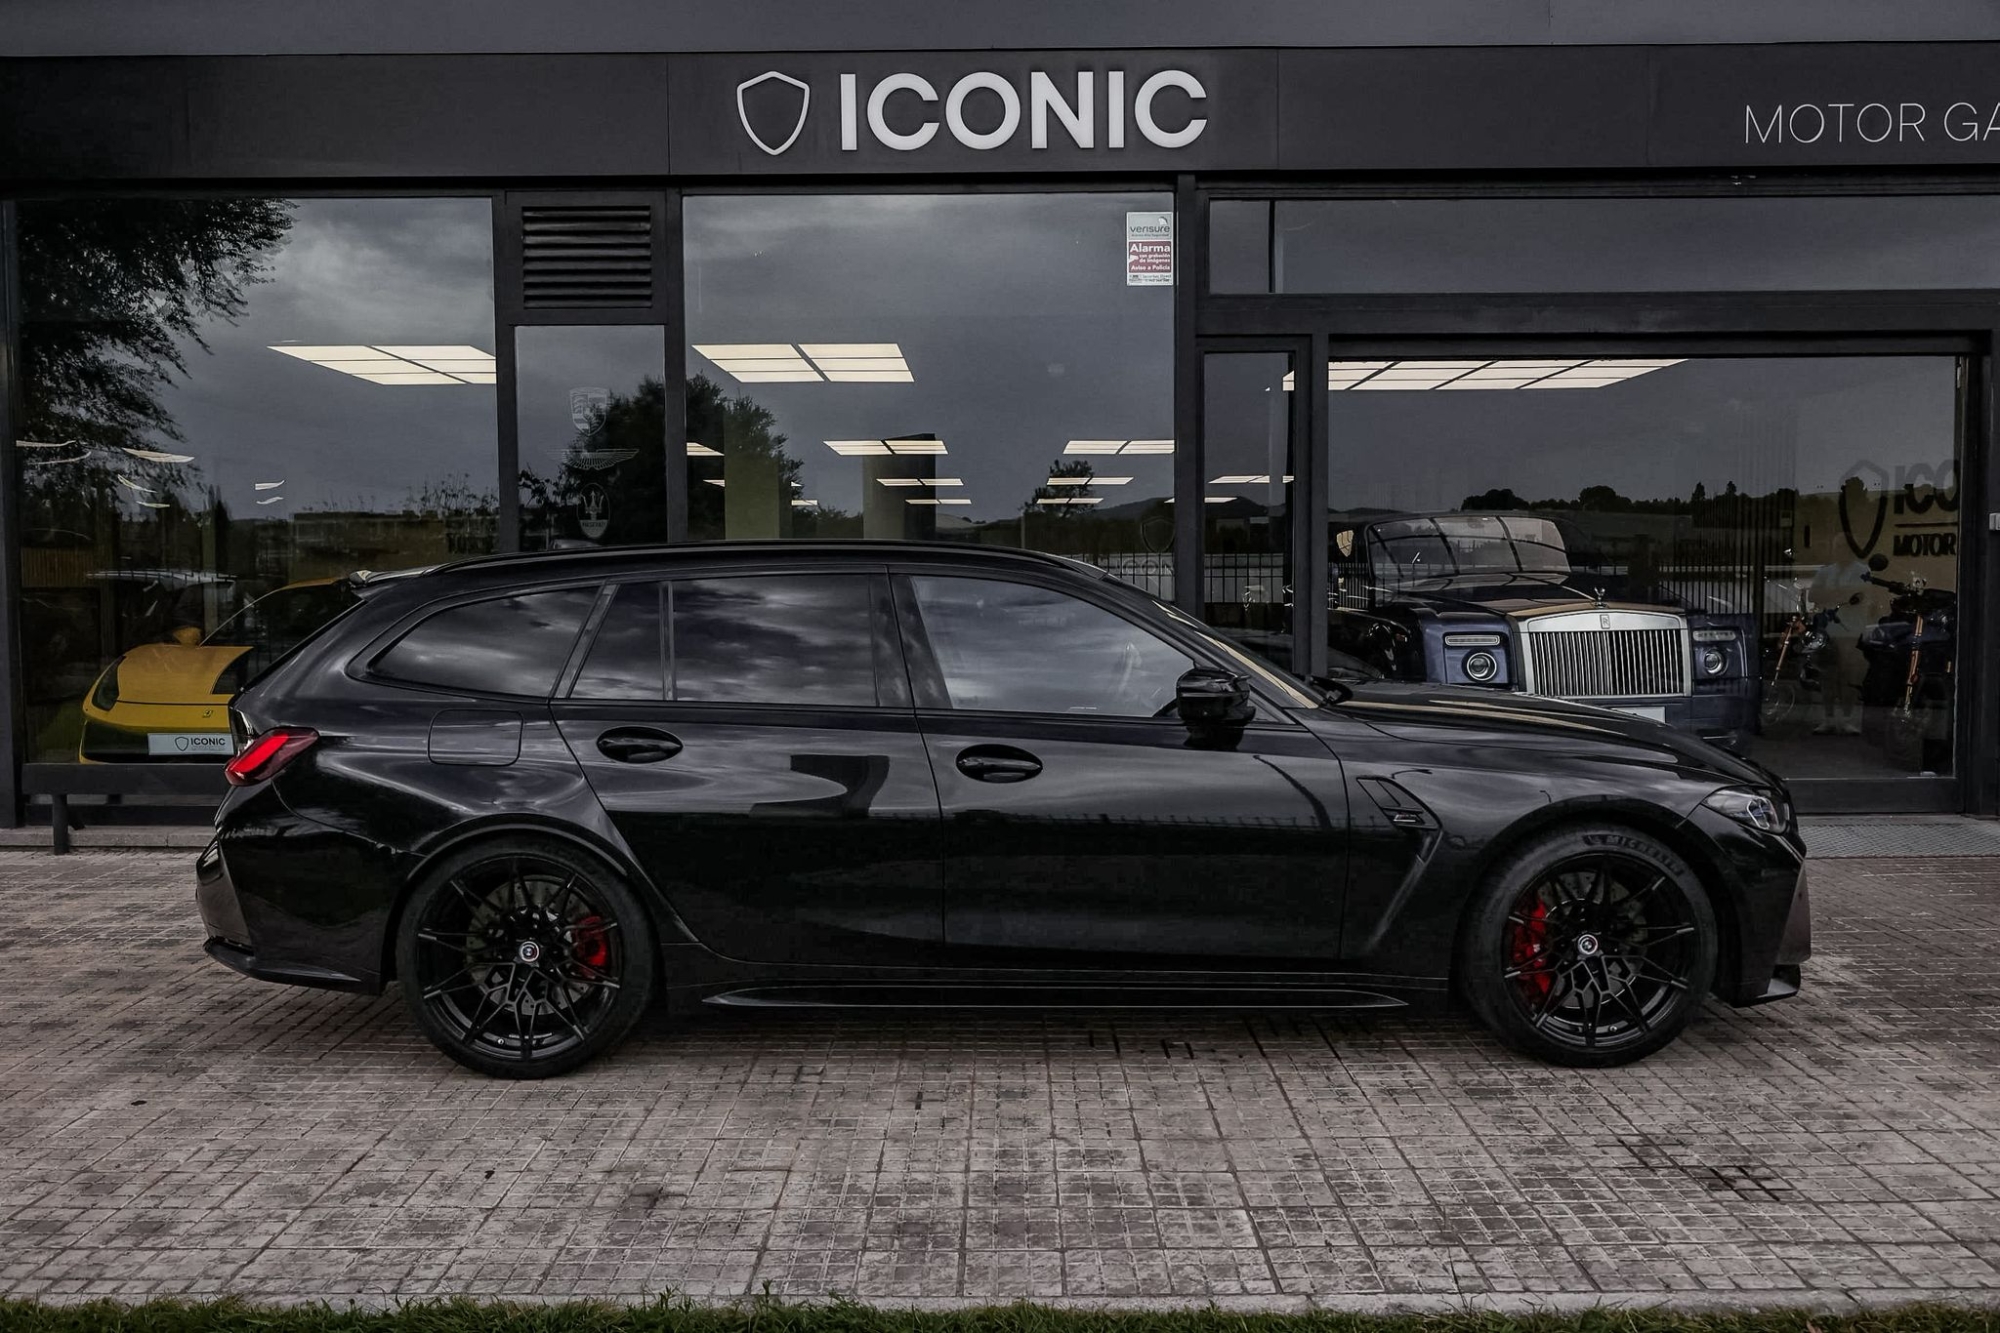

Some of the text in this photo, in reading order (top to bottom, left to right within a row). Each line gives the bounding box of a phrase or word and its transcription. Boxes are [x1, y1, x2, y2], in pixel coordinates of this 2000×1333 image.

[840, 69, 1207, 150] ICONIC
[1745, 103, 1925, 144] MOTOR
[1129, 225, 1170, 233] verisure
[1129, 243, 1170, 253] Alarma
[1893, 532, 1957, 557] MOTOR
[190, 737, 226, 746] ICONIC
